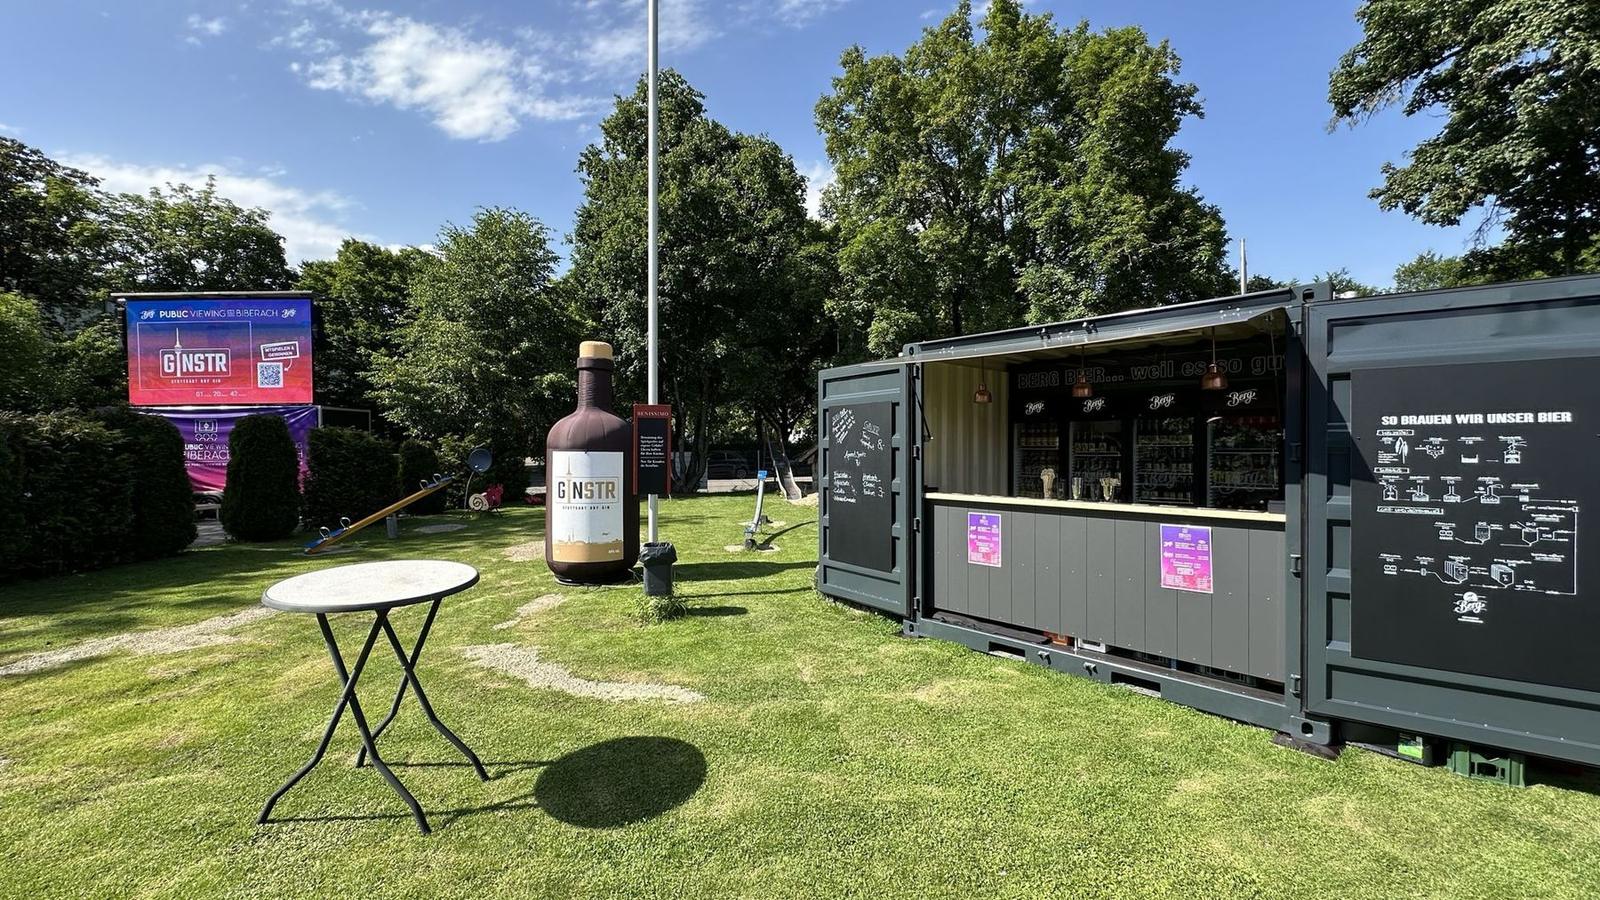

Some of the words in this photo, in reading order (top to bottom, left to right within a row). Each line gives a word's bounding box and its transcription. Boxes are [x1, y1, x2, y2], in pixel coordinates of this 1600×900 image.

[159, 310, 189, 318] PUBLIC
[190, 309, 226, 318] VIEWING
[235, 308, 279, 318] BIBERACH
[163, 352, 228, 375] GINSTR
[1130, 360, 1175, 381] weil
[1251, 354, 1286, 376] gu
[1381, 415, 1398, 426] SO
[1400, 414, 1452, 426] BRAUEN
[1455, 413, 1484, 424] WIR
[1486, 412, 1534, 424] UNSER
[1537, 411, 1573, 423] BIER
[557, 481, 616, 500] GINSTR
